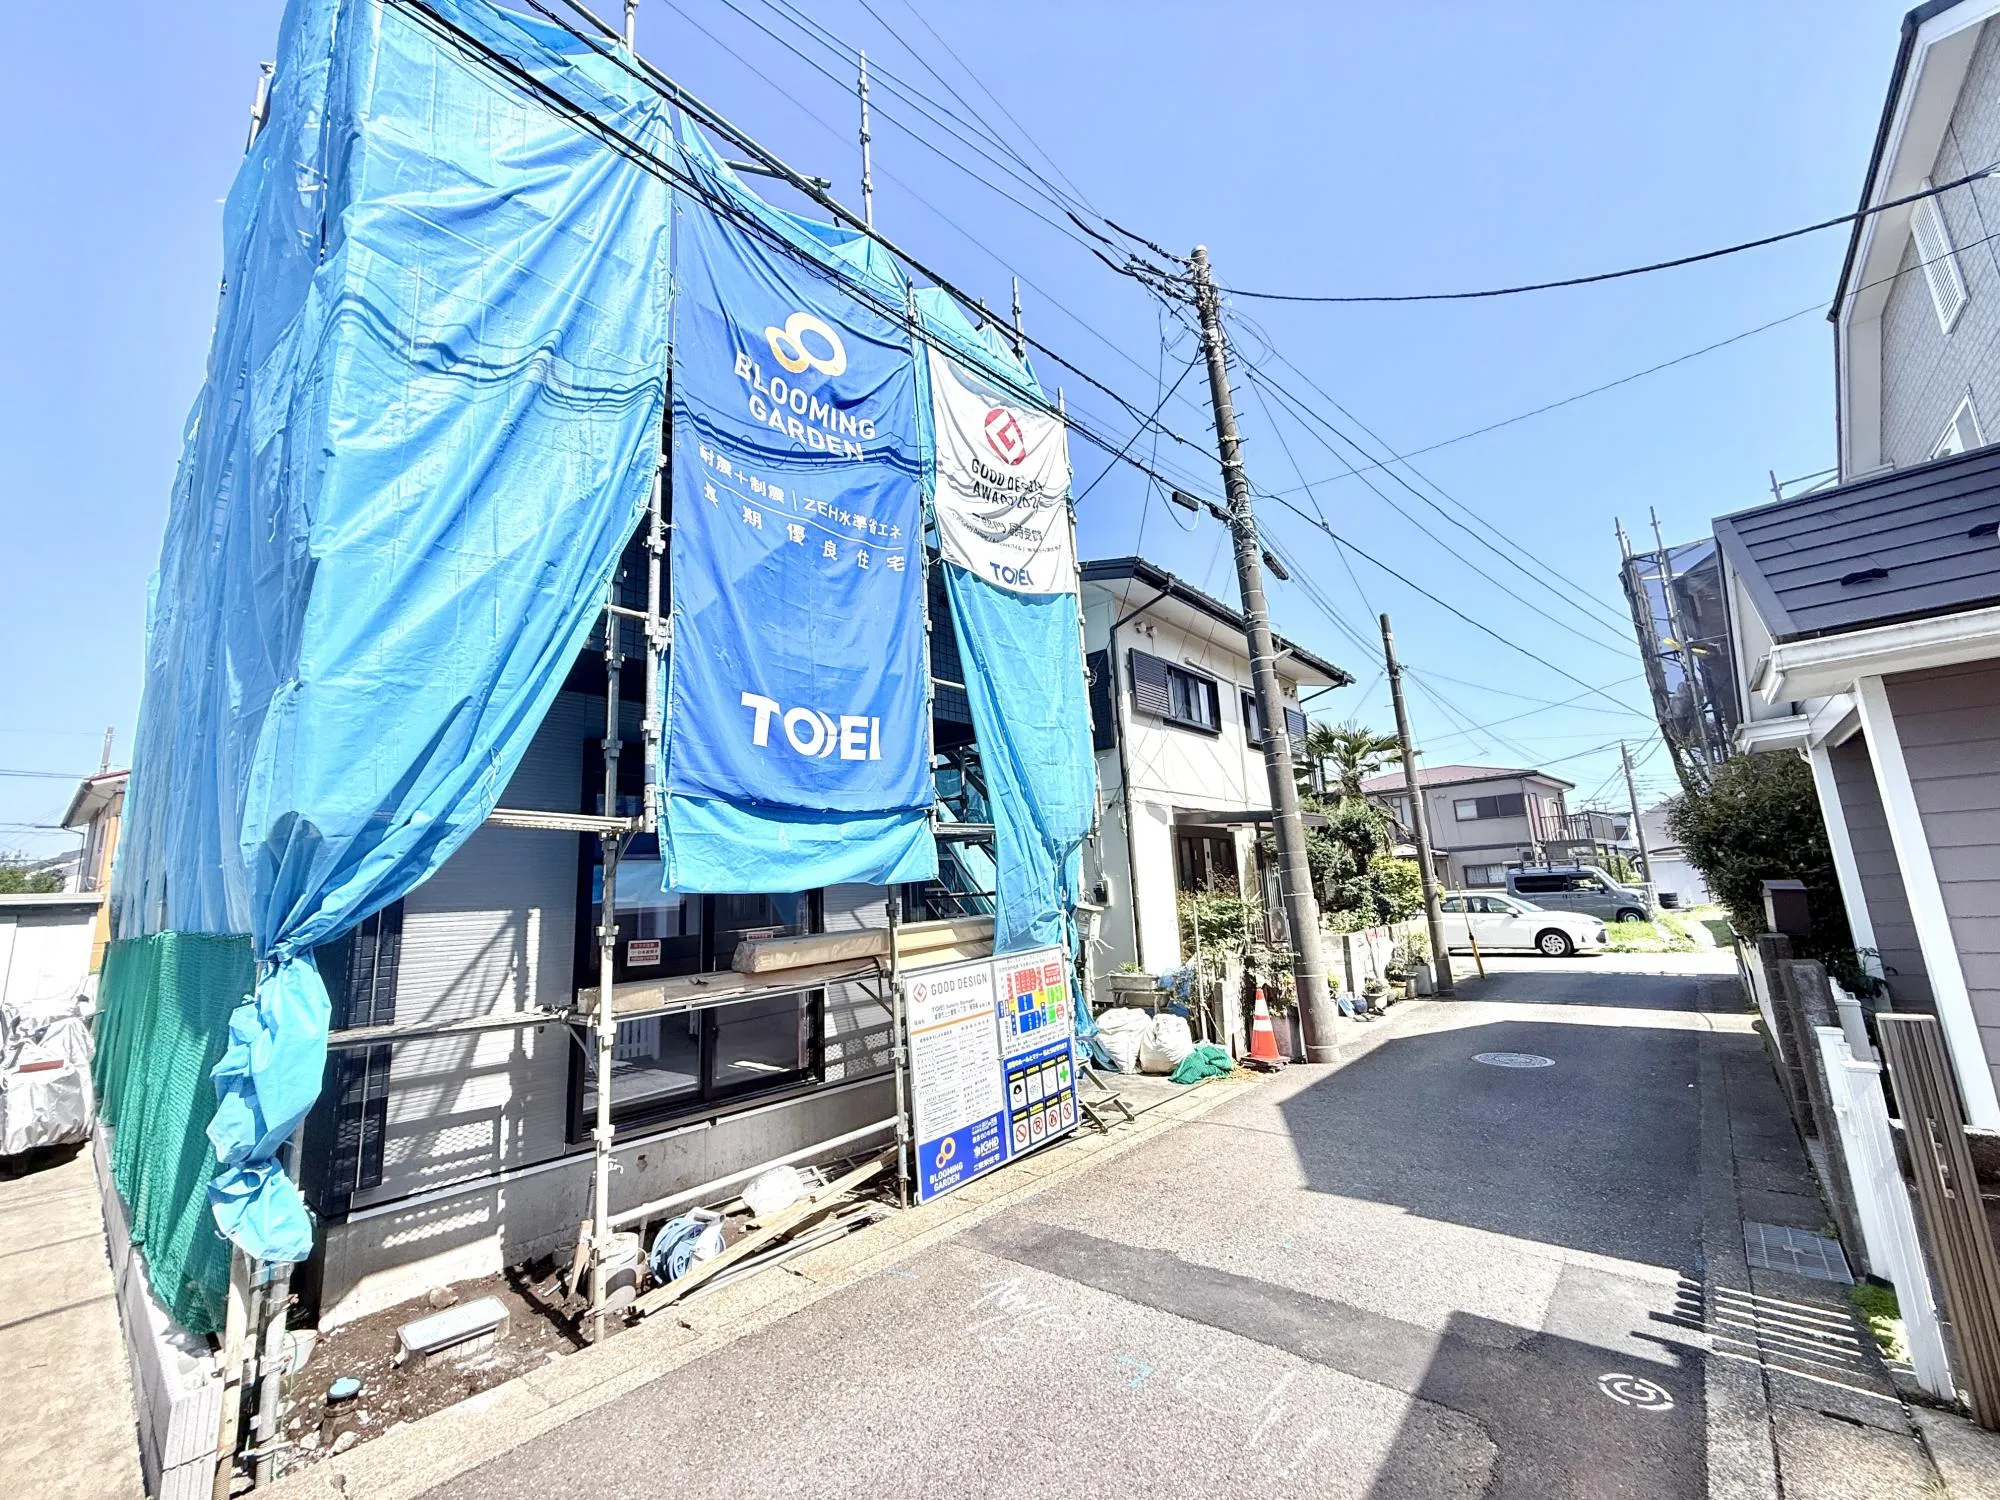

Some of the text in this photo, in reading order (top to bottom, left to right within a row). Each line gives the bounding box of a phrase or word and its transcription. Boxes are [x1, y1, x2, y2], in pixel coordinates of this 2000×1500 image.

[733, 349, 876, 440] BLOOMING
[748, 393, 864, 463] GARDEN
[971, 458, 1005, 487] GOOD
[740, 691, 882, 761] TOEI
[930, 980, 956, 996] GOOD
[957, 973, 988, 990] DESIGN
[929, 1161, 964, 1185] BLOOMING
[933, 1172, 961, 1192] GARDEN
